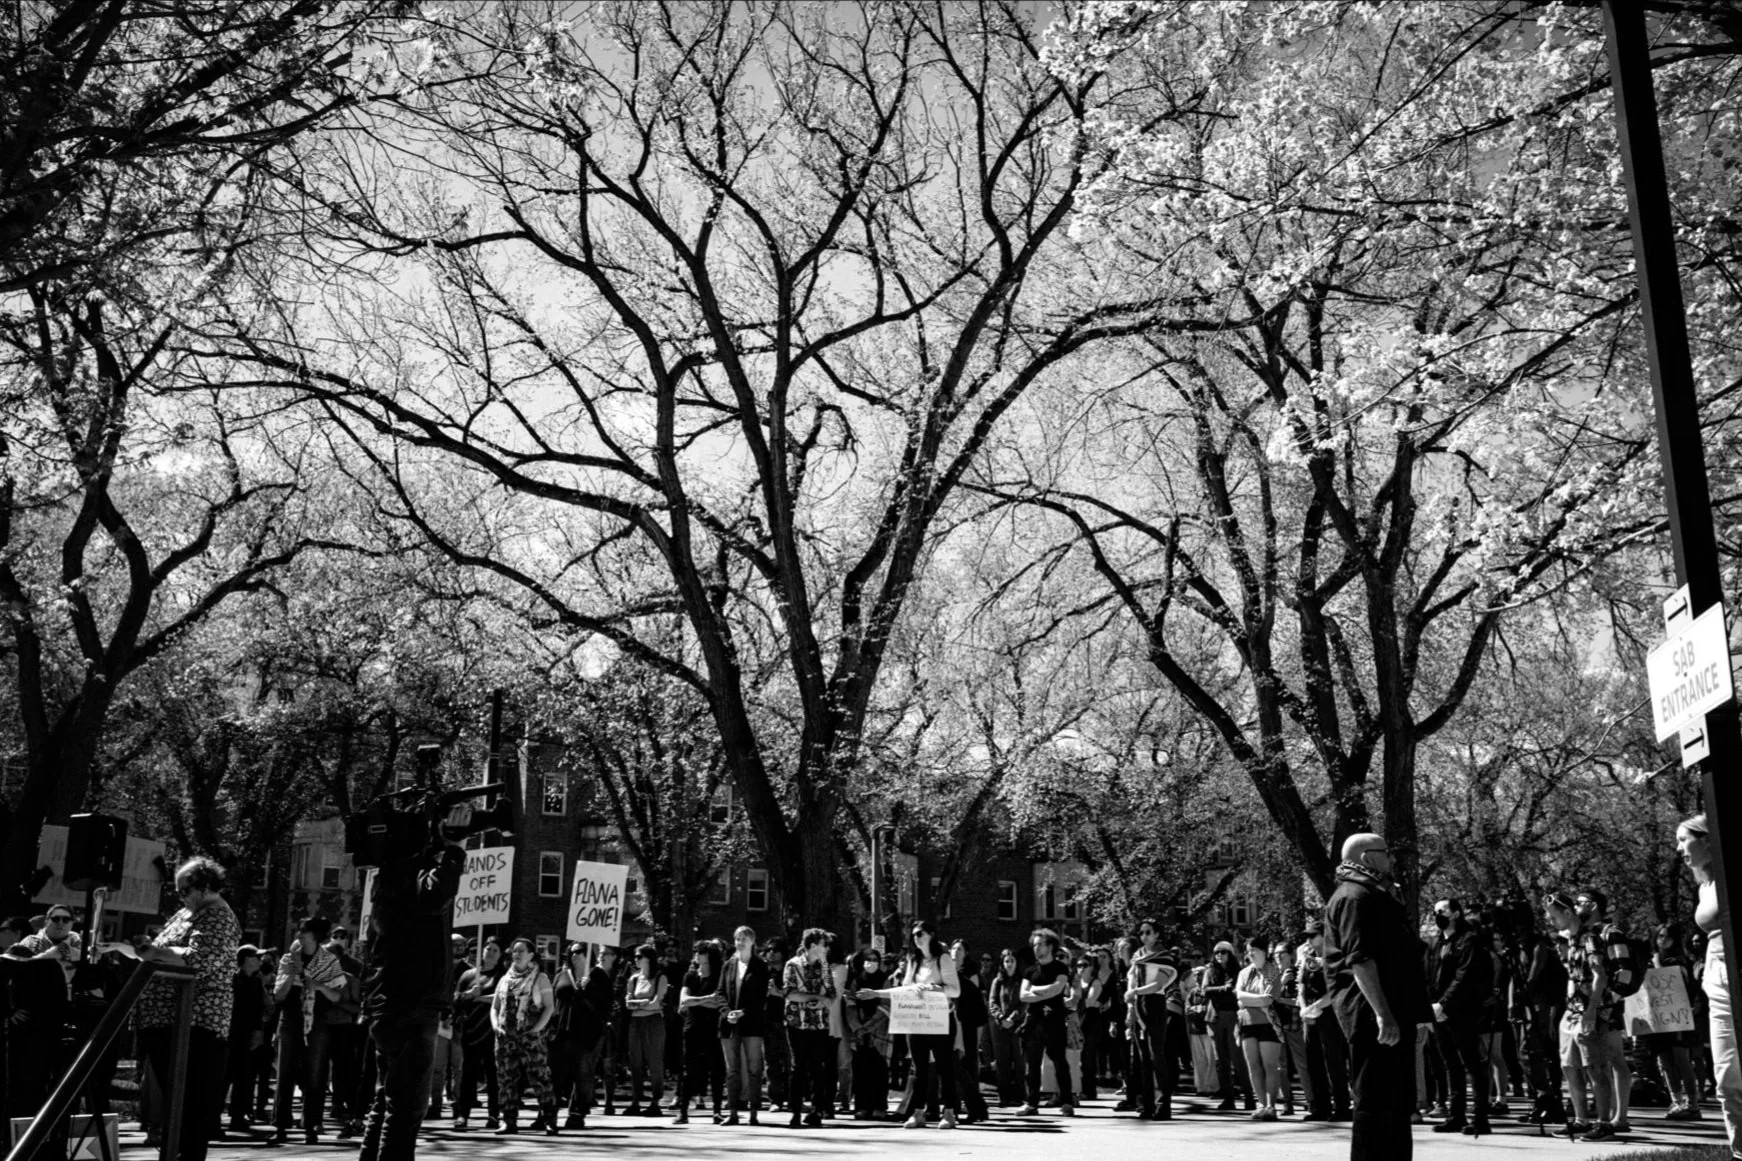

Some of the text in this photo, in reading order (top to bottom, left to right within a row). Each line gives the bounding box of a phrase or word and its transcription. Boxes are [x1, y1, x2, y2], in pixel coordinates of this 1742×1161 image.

[1673, 640, 1695, 677] SAB
[1660, 662, 1720, 723] ENTRANCE
[469, 874, 497, 891] OFF
[574, 877, 619, 906] FLANA
[455, 892, 509, 919] STUDENTS
[575, 906, 619, 932] GONE!
